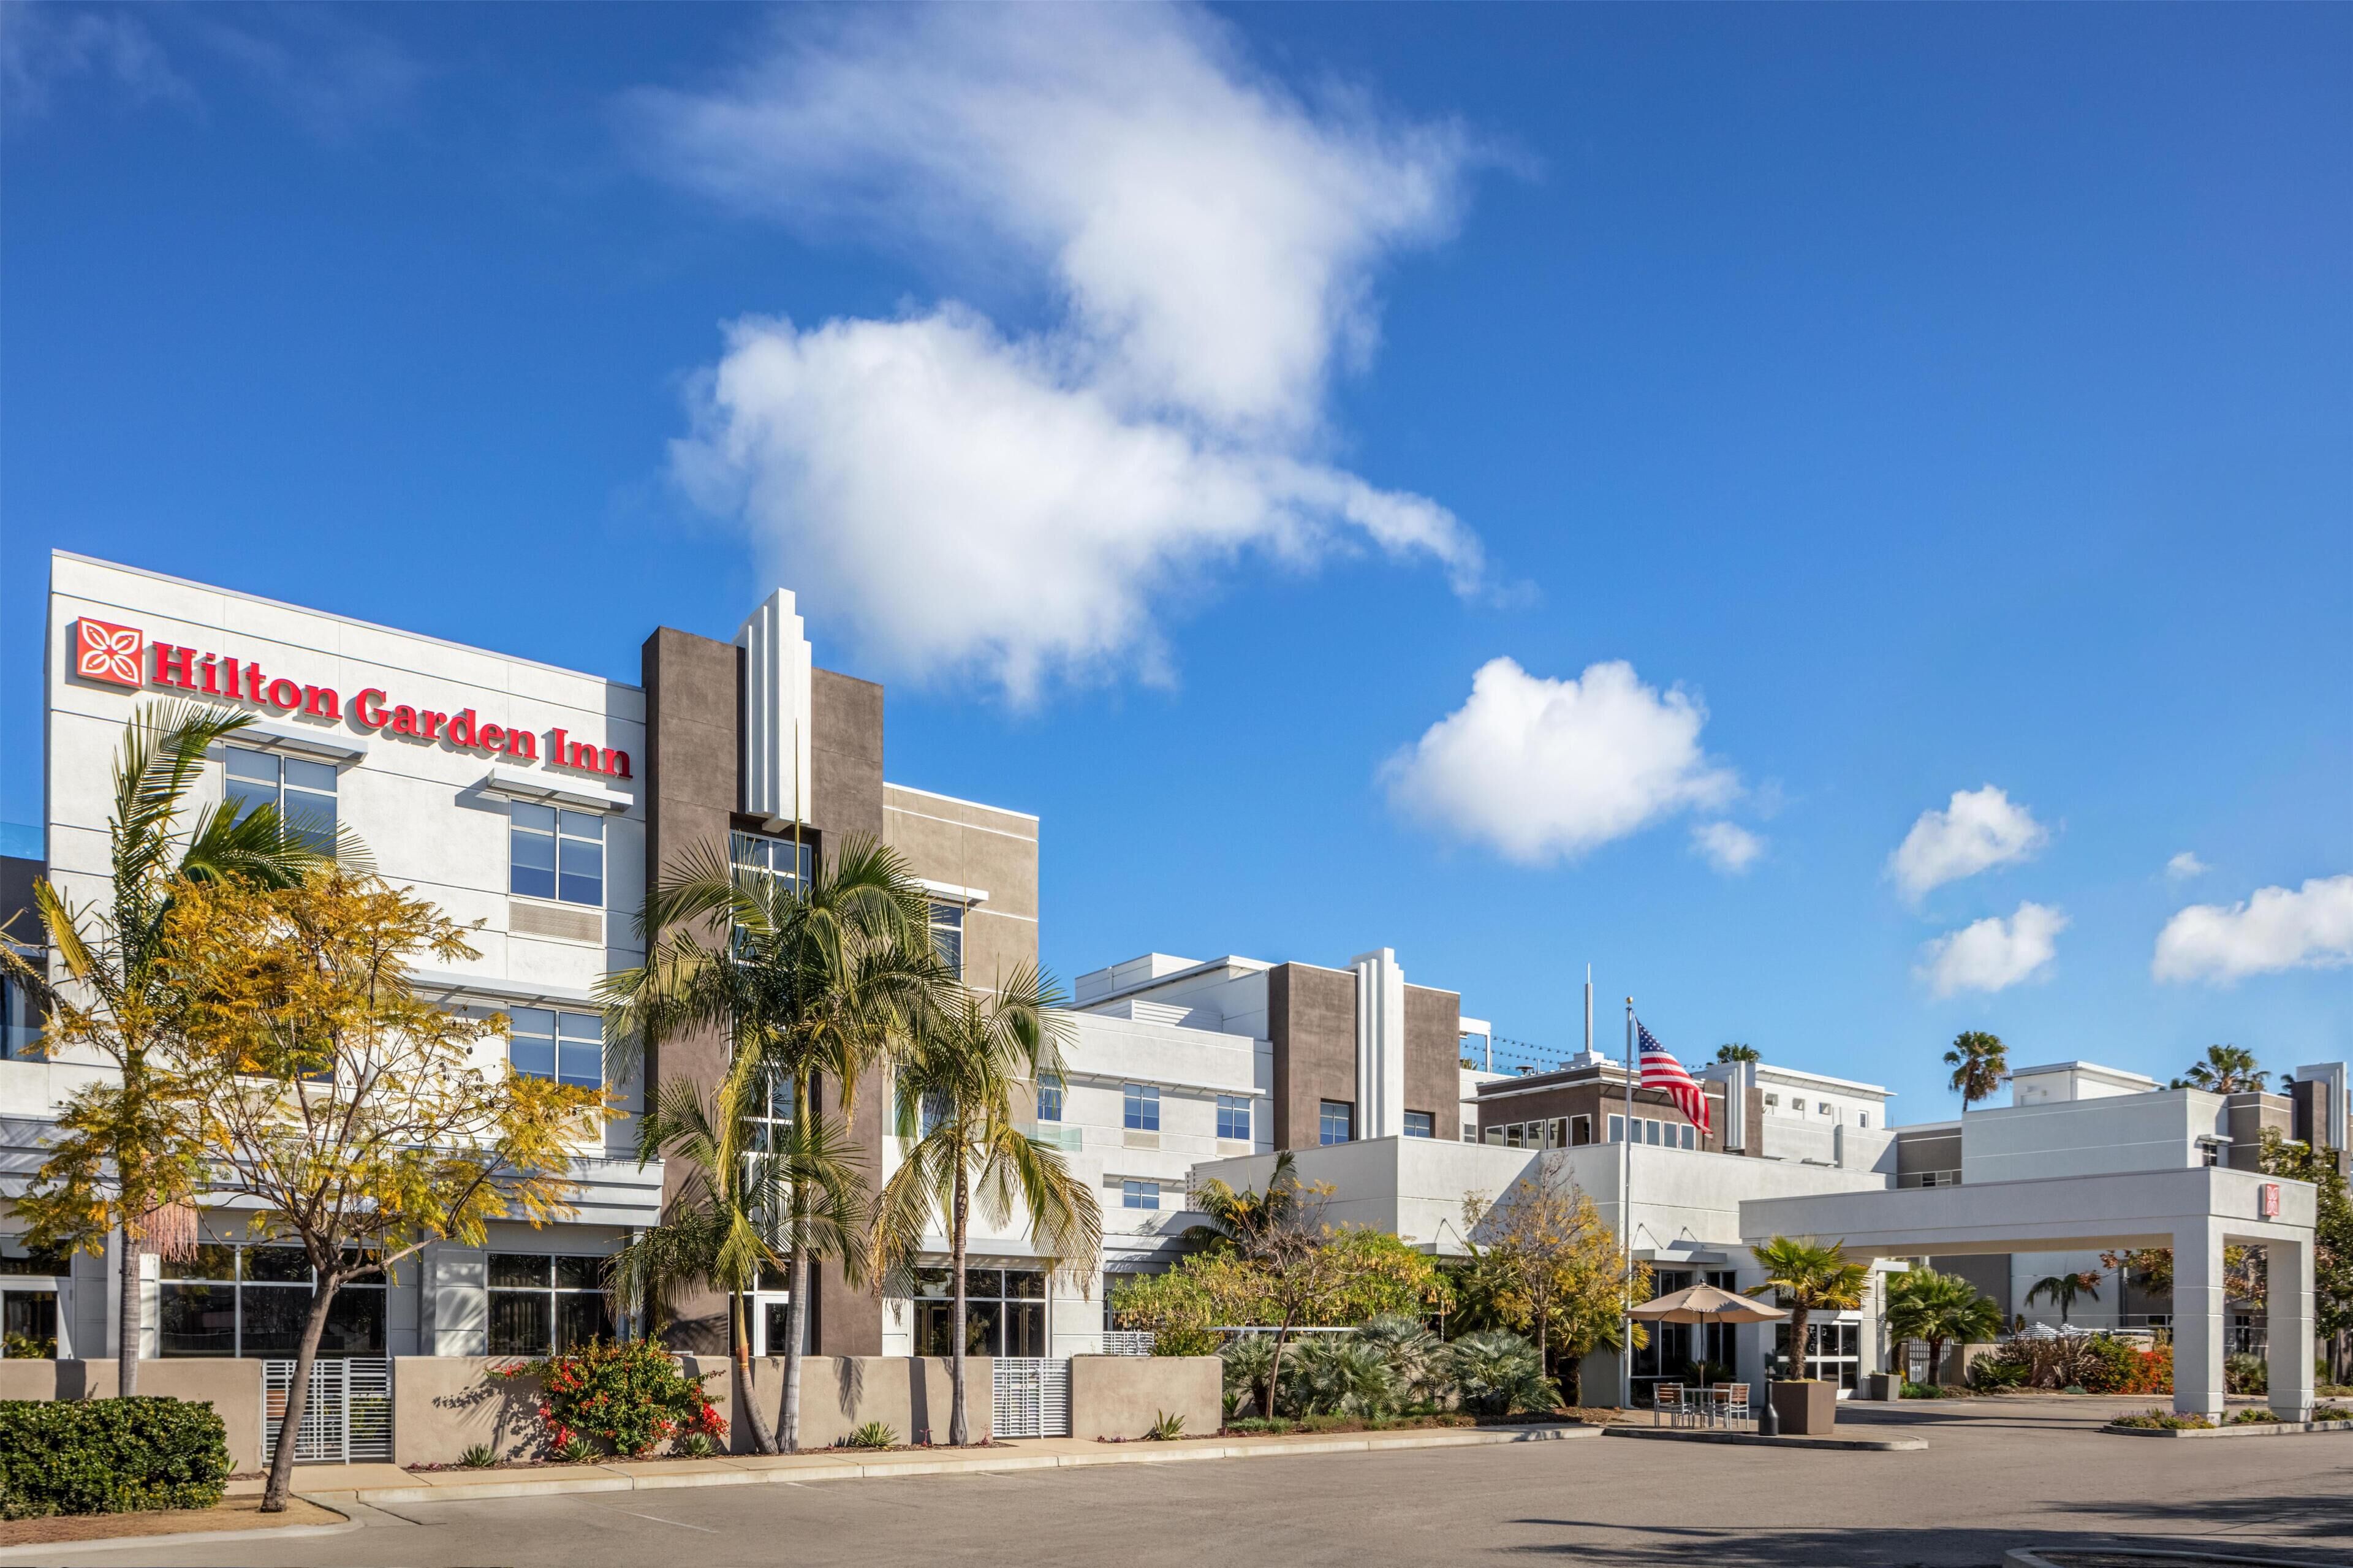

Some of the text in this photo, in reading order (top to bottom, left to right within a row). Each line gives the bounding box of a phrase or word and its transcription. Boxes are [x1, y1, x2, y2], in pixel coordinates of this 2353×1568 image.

[152, 641, 633, 779] Hilton Garden Inn
